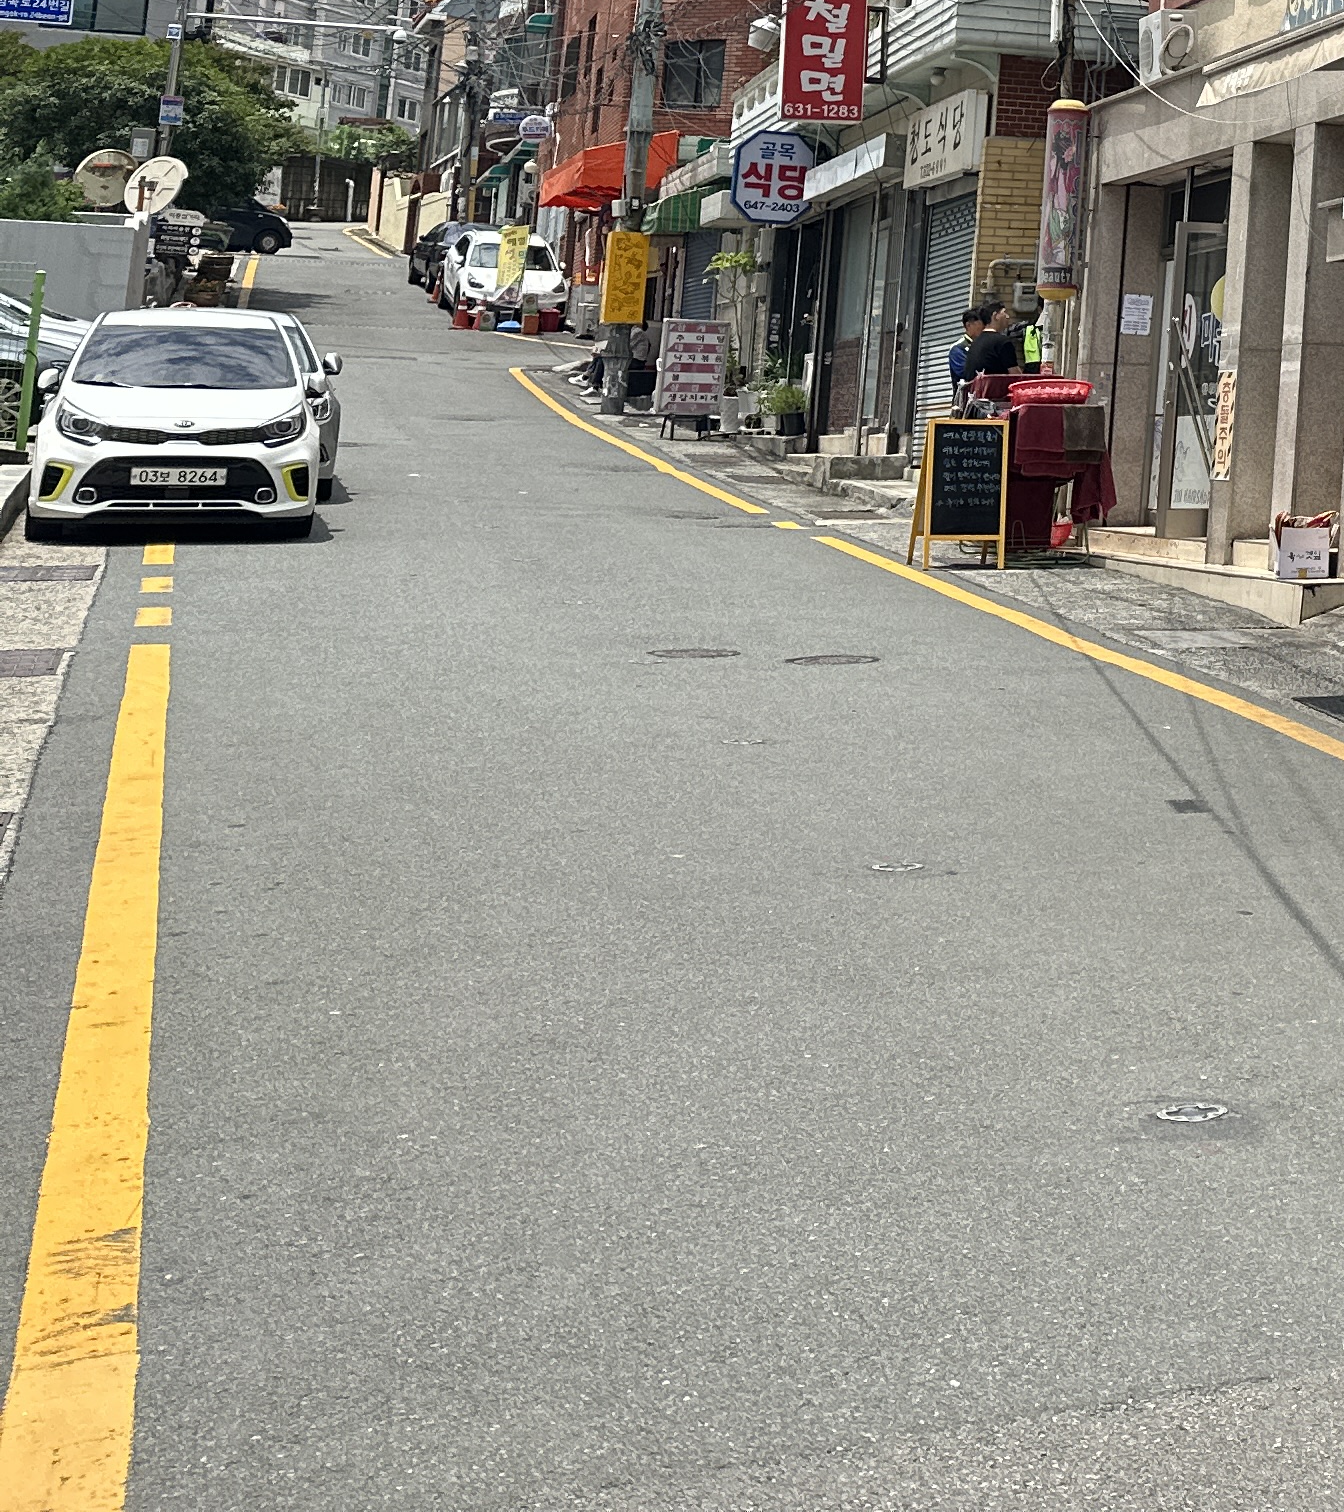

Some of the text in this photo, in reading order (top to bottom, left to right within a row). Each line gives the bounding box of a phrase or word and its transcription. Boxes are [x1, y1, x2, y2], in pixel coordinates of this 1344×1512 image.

[783, 101, 859, 119] 631-1283
[758, 141, 797, 161] 골목
[741, 160, 808, 202] 식당
[743, 200, 801, 214] 647-2403
[1217, 380, 1232, 470] 충돌주의
[177, 470, 218, 483] 8264
